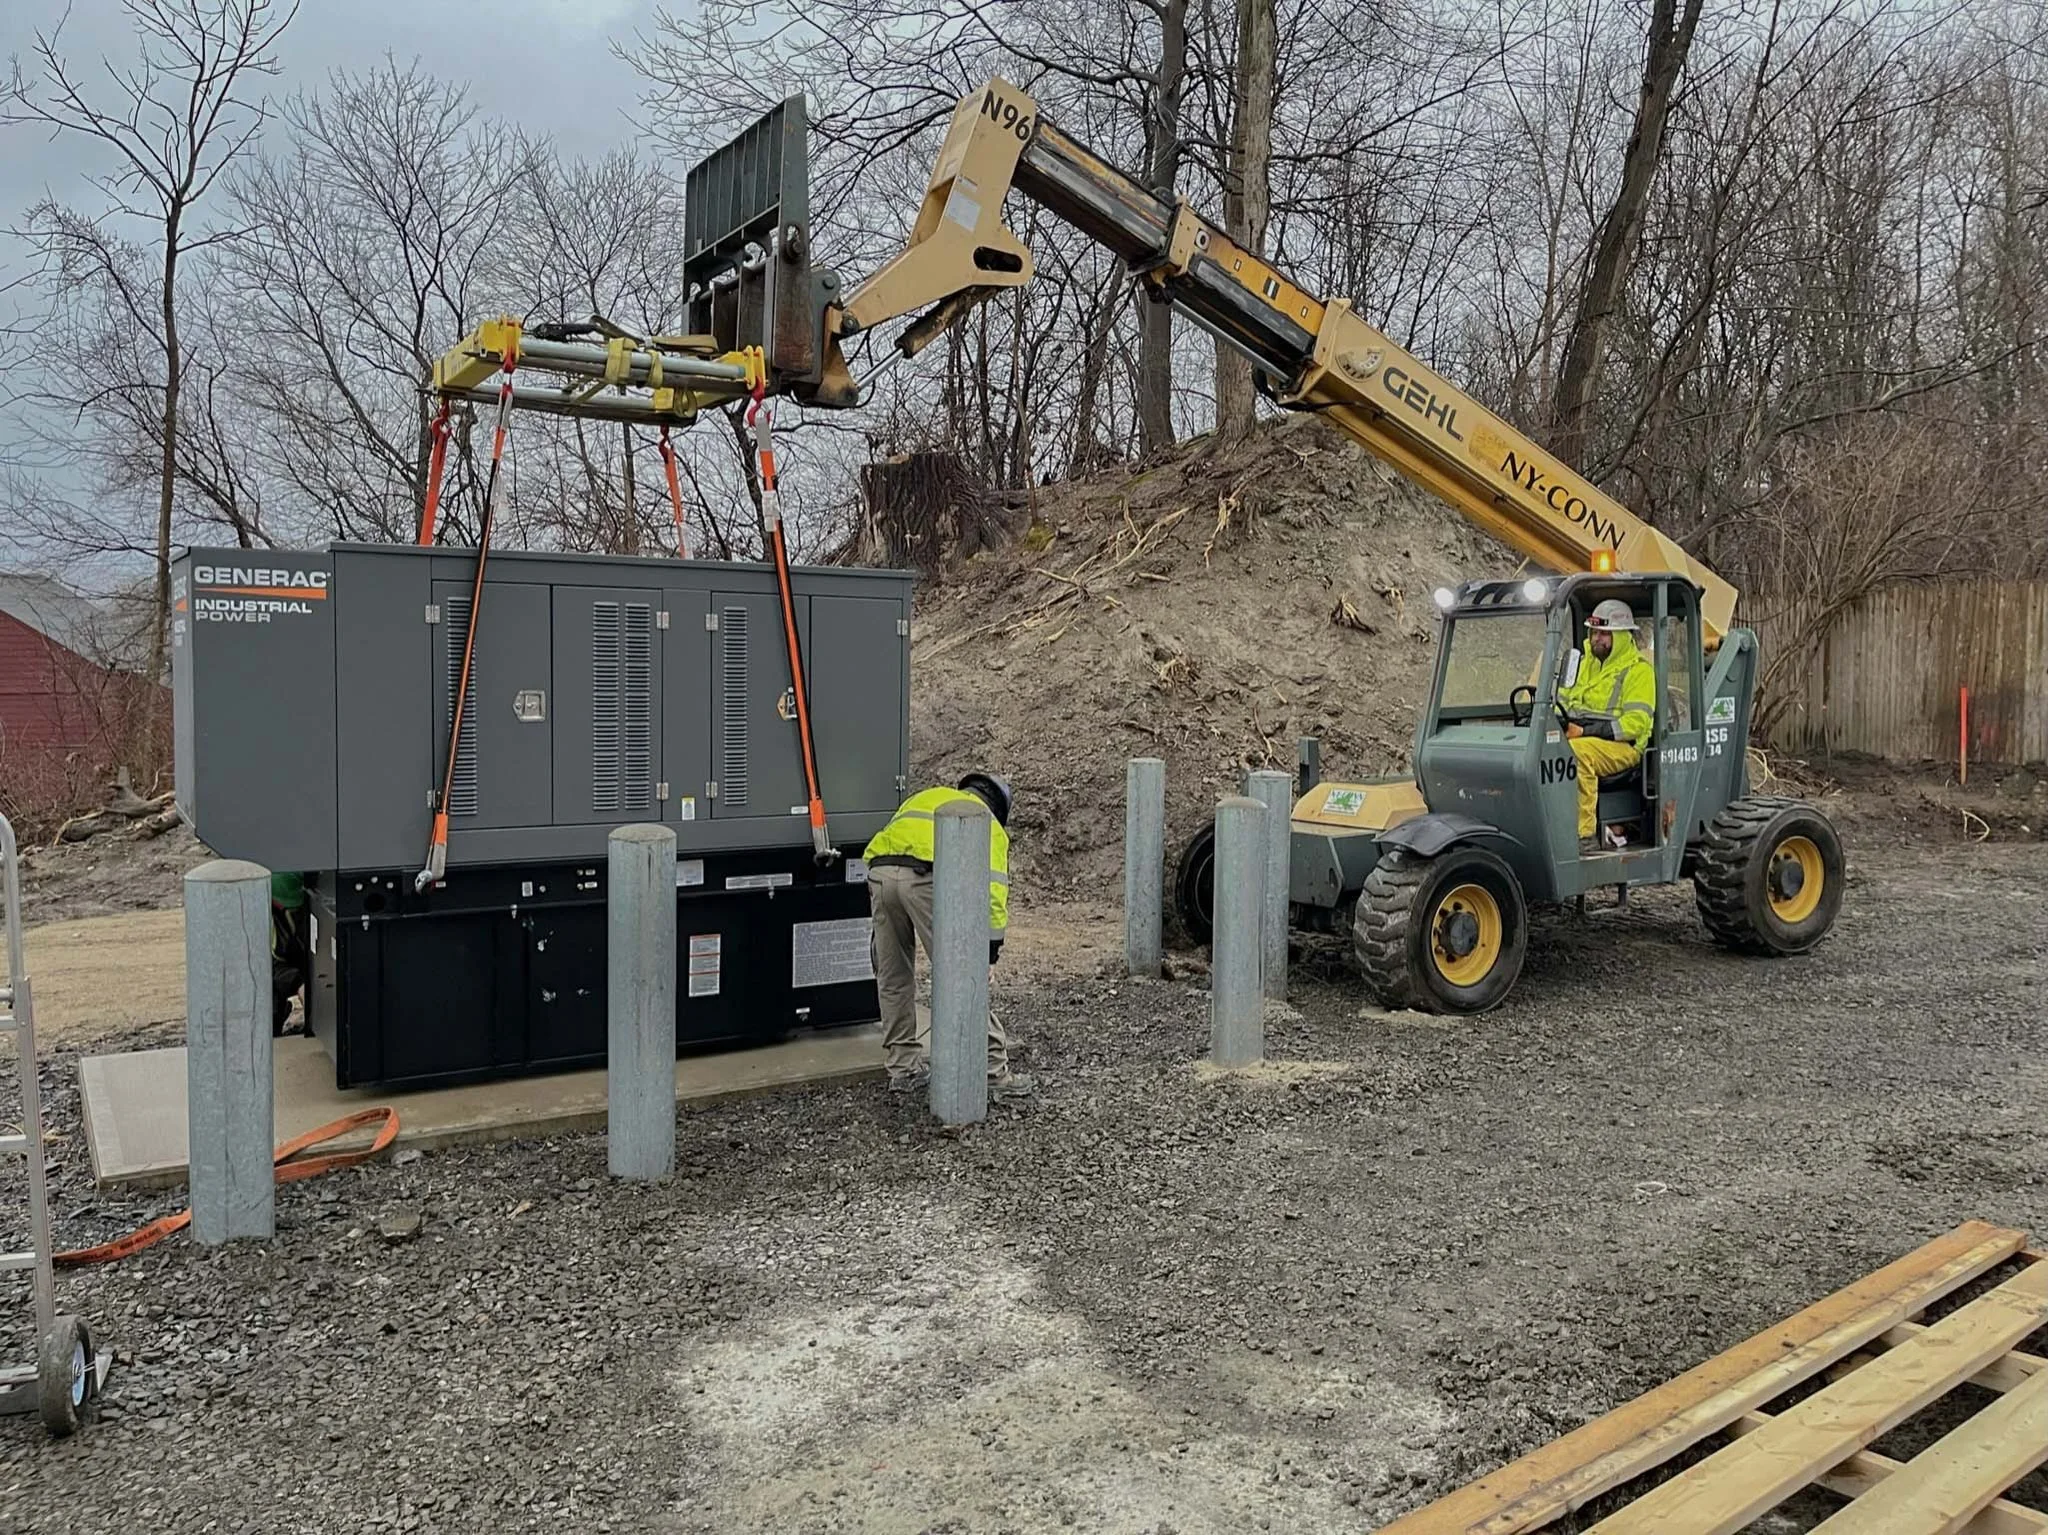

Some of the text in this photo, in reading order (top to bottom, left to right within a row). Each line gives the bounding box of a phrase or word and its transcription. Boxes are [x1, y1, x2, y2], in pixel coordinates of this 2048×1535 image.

[981, 90, 1030, 141] N96
[1383, 366, 1463, 442] GEHL
[1500, 451, 1625, 550] NY-CONN
[194, 566, 327, 588] GENERAC
[195, 598, 312, 614] INDUSTRIAL
[195, 611, 271, 623] POWER
[1540, 756, 1577, 785] N96
